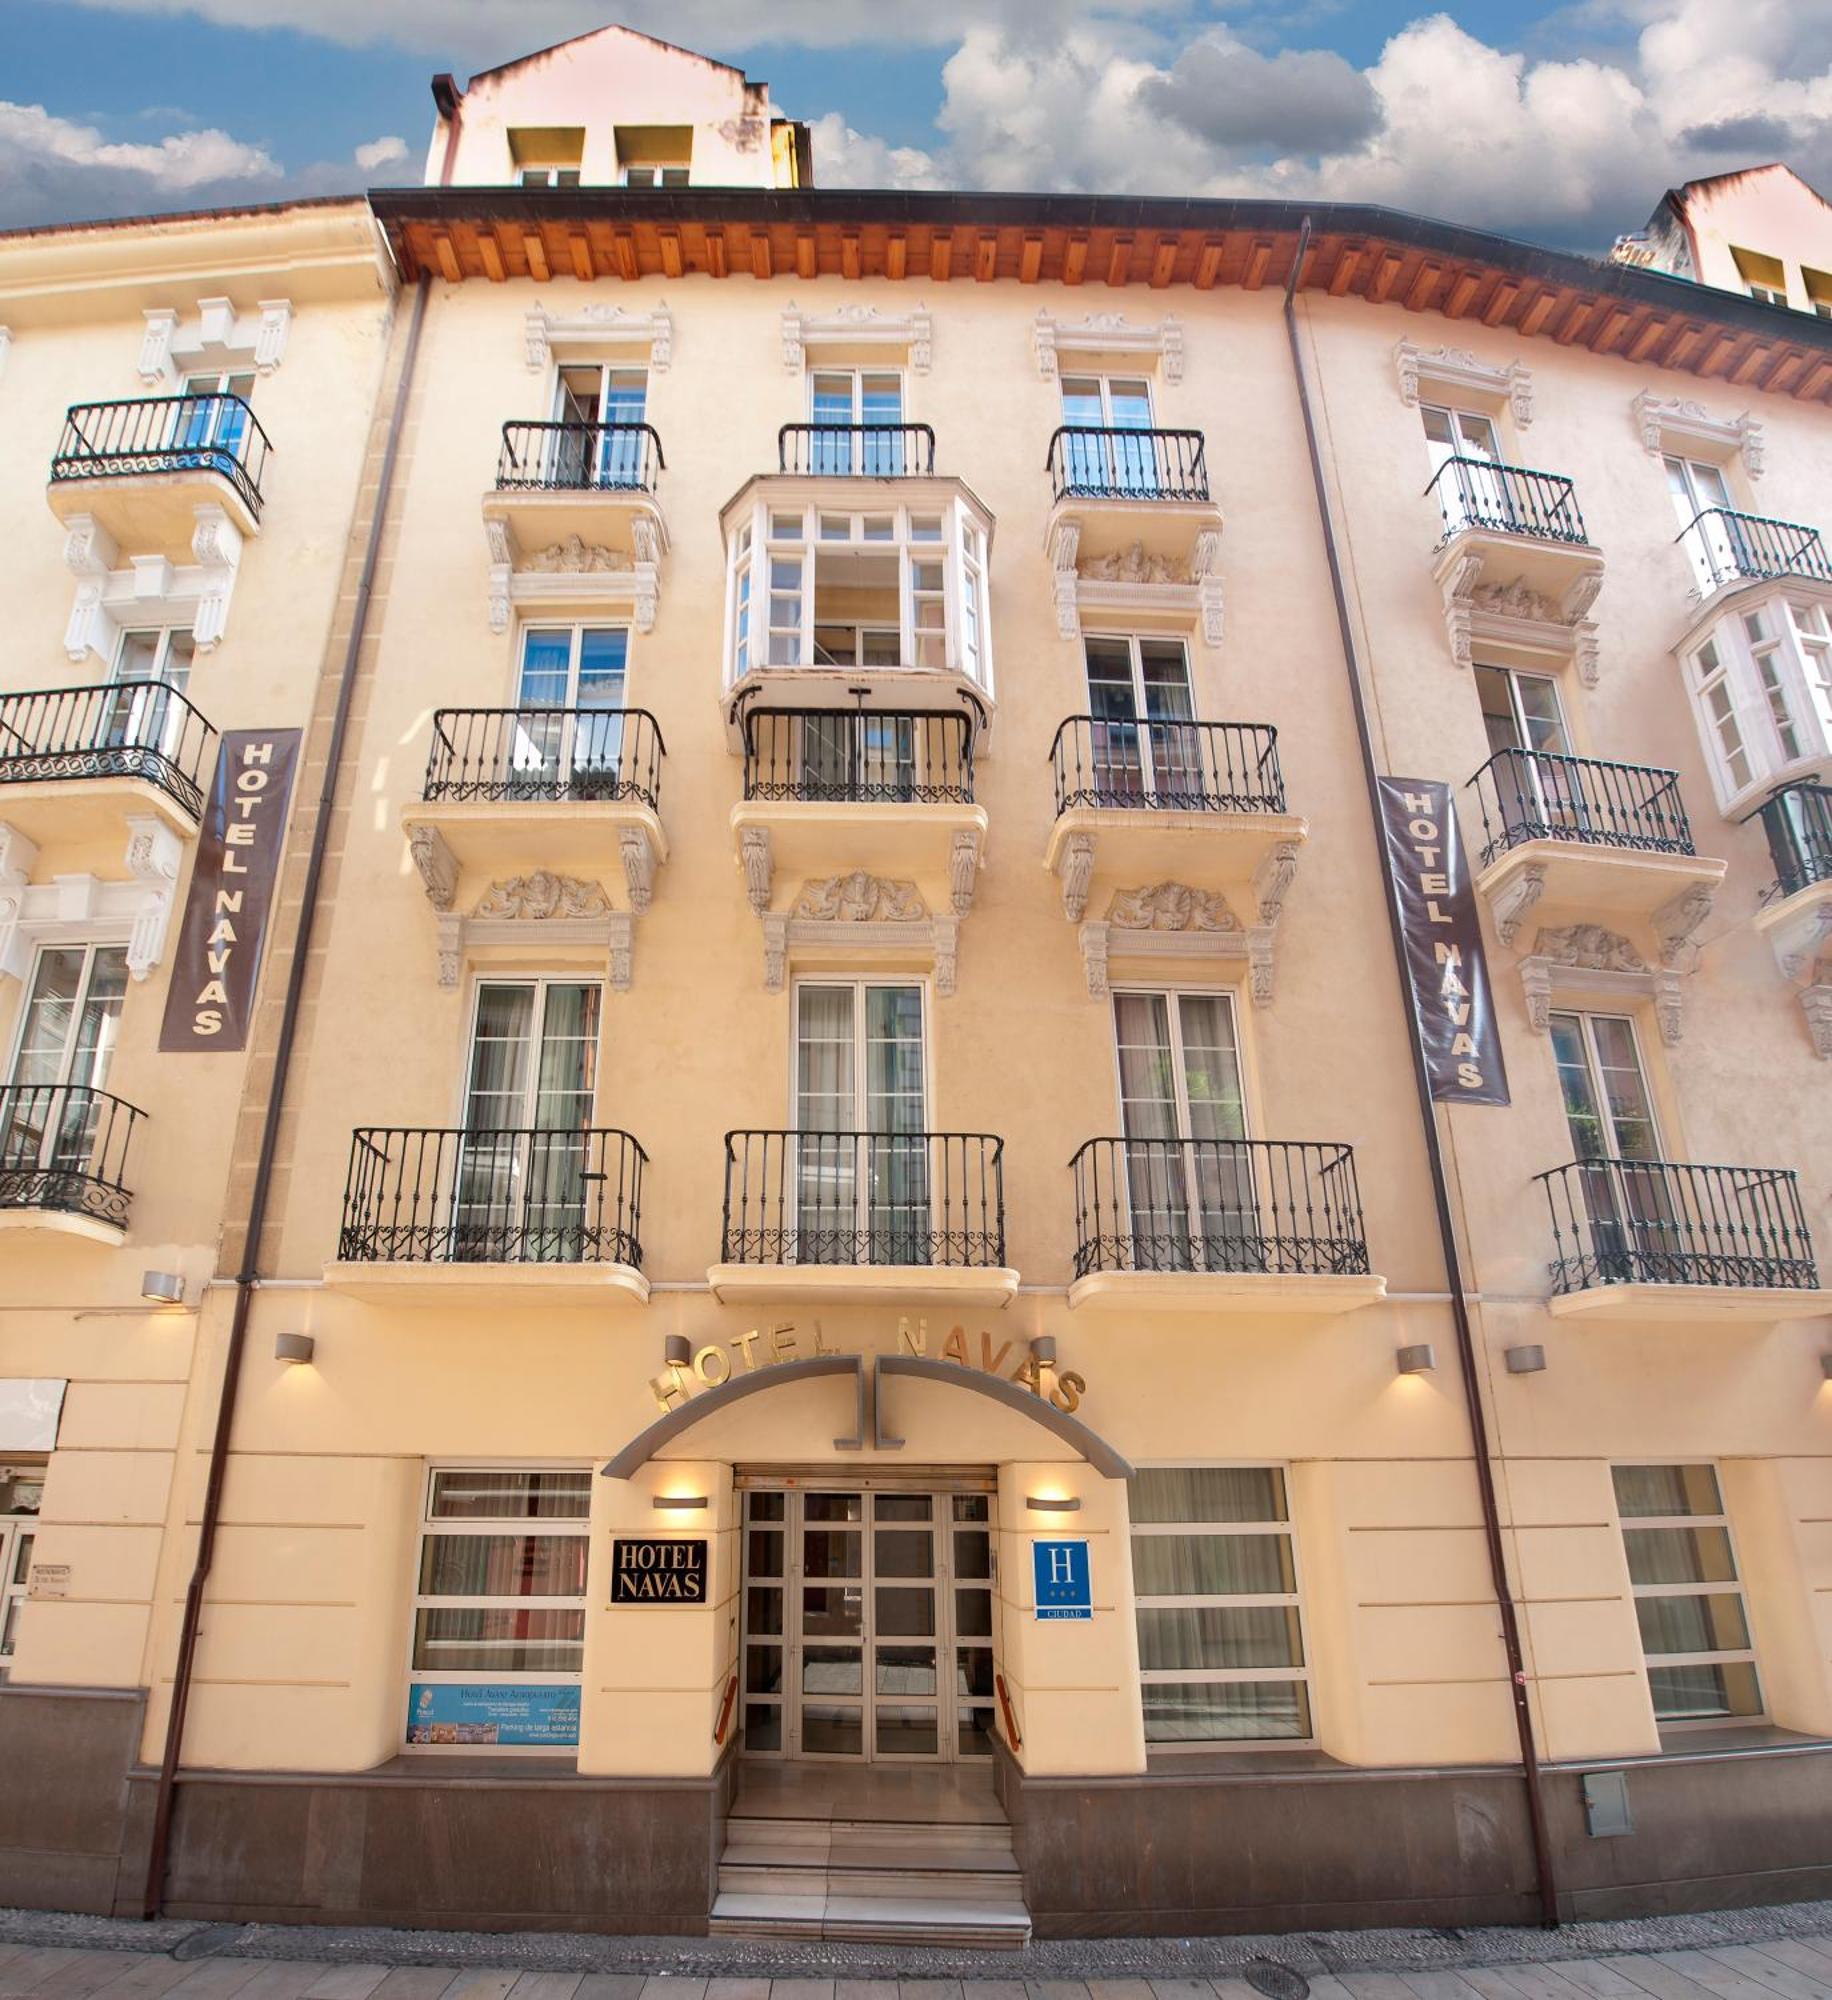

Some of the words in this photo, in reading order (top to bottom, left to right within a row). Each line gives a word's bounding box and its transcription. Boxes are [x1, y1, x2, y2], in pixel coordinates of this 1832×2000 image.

[223, 743, 272, 873] HOTEL
[193, 890, 243, 1035] NAVAS
[1405, 792, 1453, 923] HOTEL
[1434, 942, 1484, 1088] NAVAS
[647, 1319, 842, 1415] HOTEL
[898, 1316, 1088, 1414] NAVAS
[618, 1572, 700, 1597] NAVAS
[620, 1544, 701, 1569] HOTEL
[1047, 1548, 1076, 1584] H
[1047, 1609, 1082, 1618] CIUDAD
